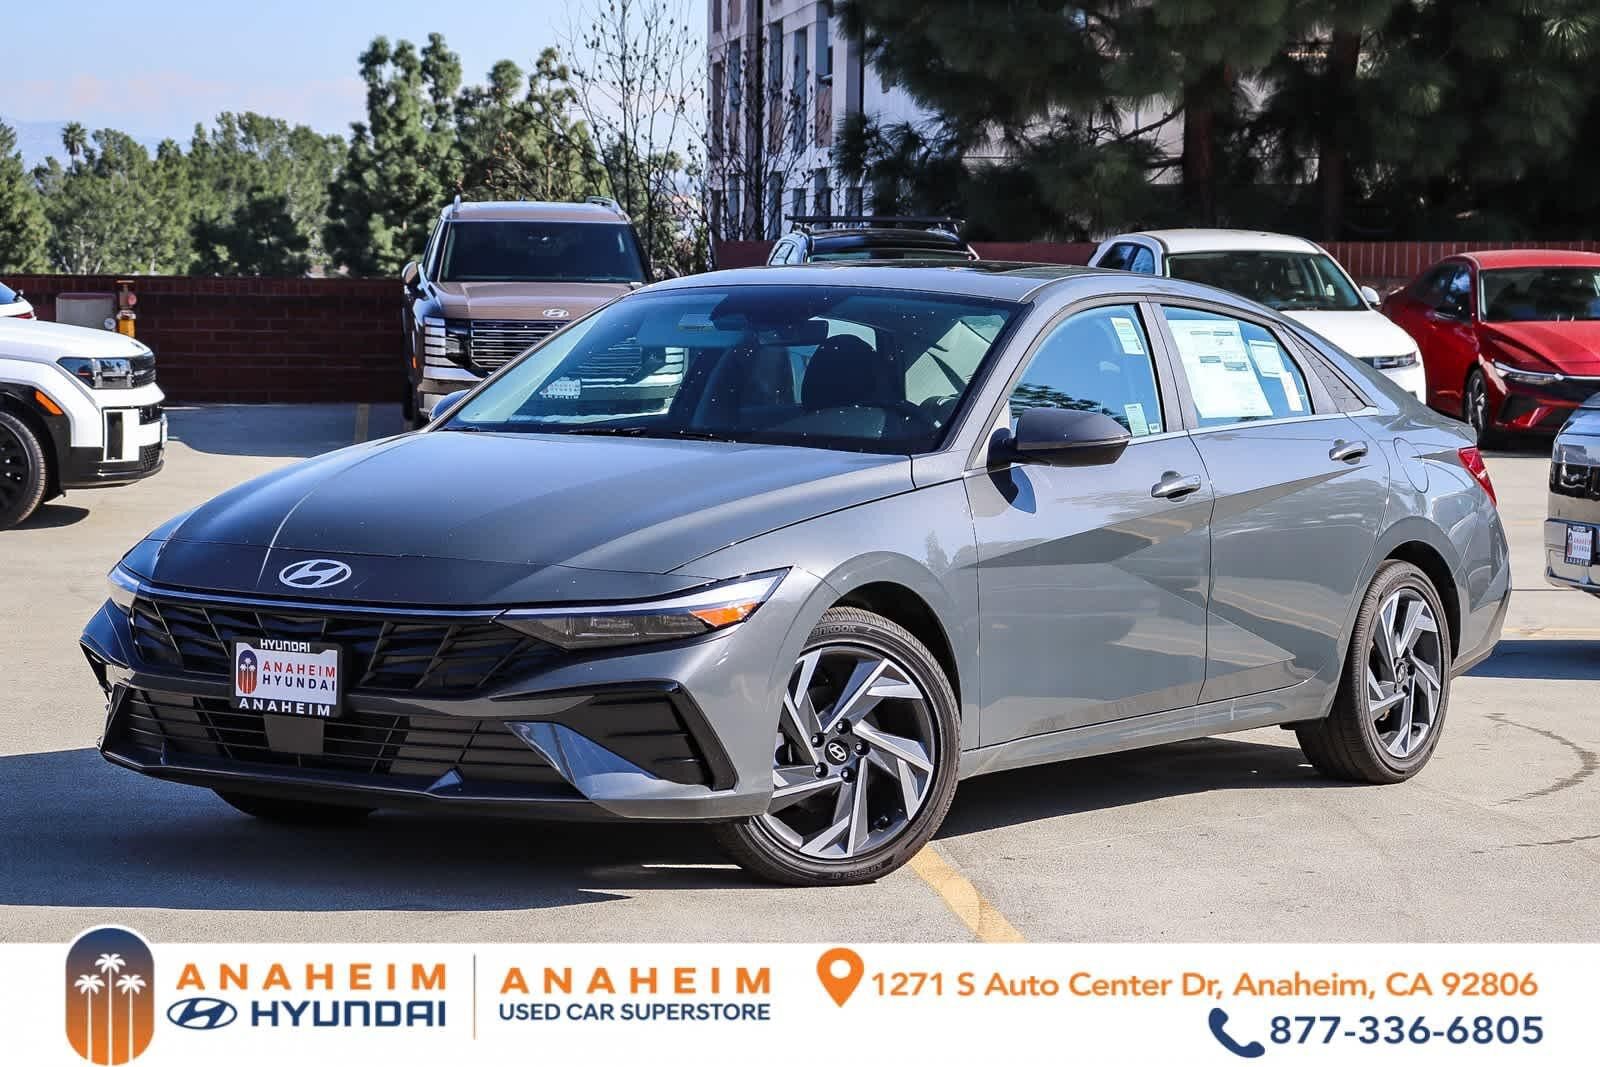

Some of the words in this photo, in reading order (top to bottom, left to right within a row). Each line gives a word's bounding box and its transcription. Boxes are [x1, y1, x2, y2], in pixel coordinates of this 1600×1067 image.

[260, 639, 310, 652] HYUNDAI
[262, 661, 335, 678] ANAHEIM
[262, 675, 335, 692] HYUNDAI
[239, 698, 330, 716] ANAHEIM
